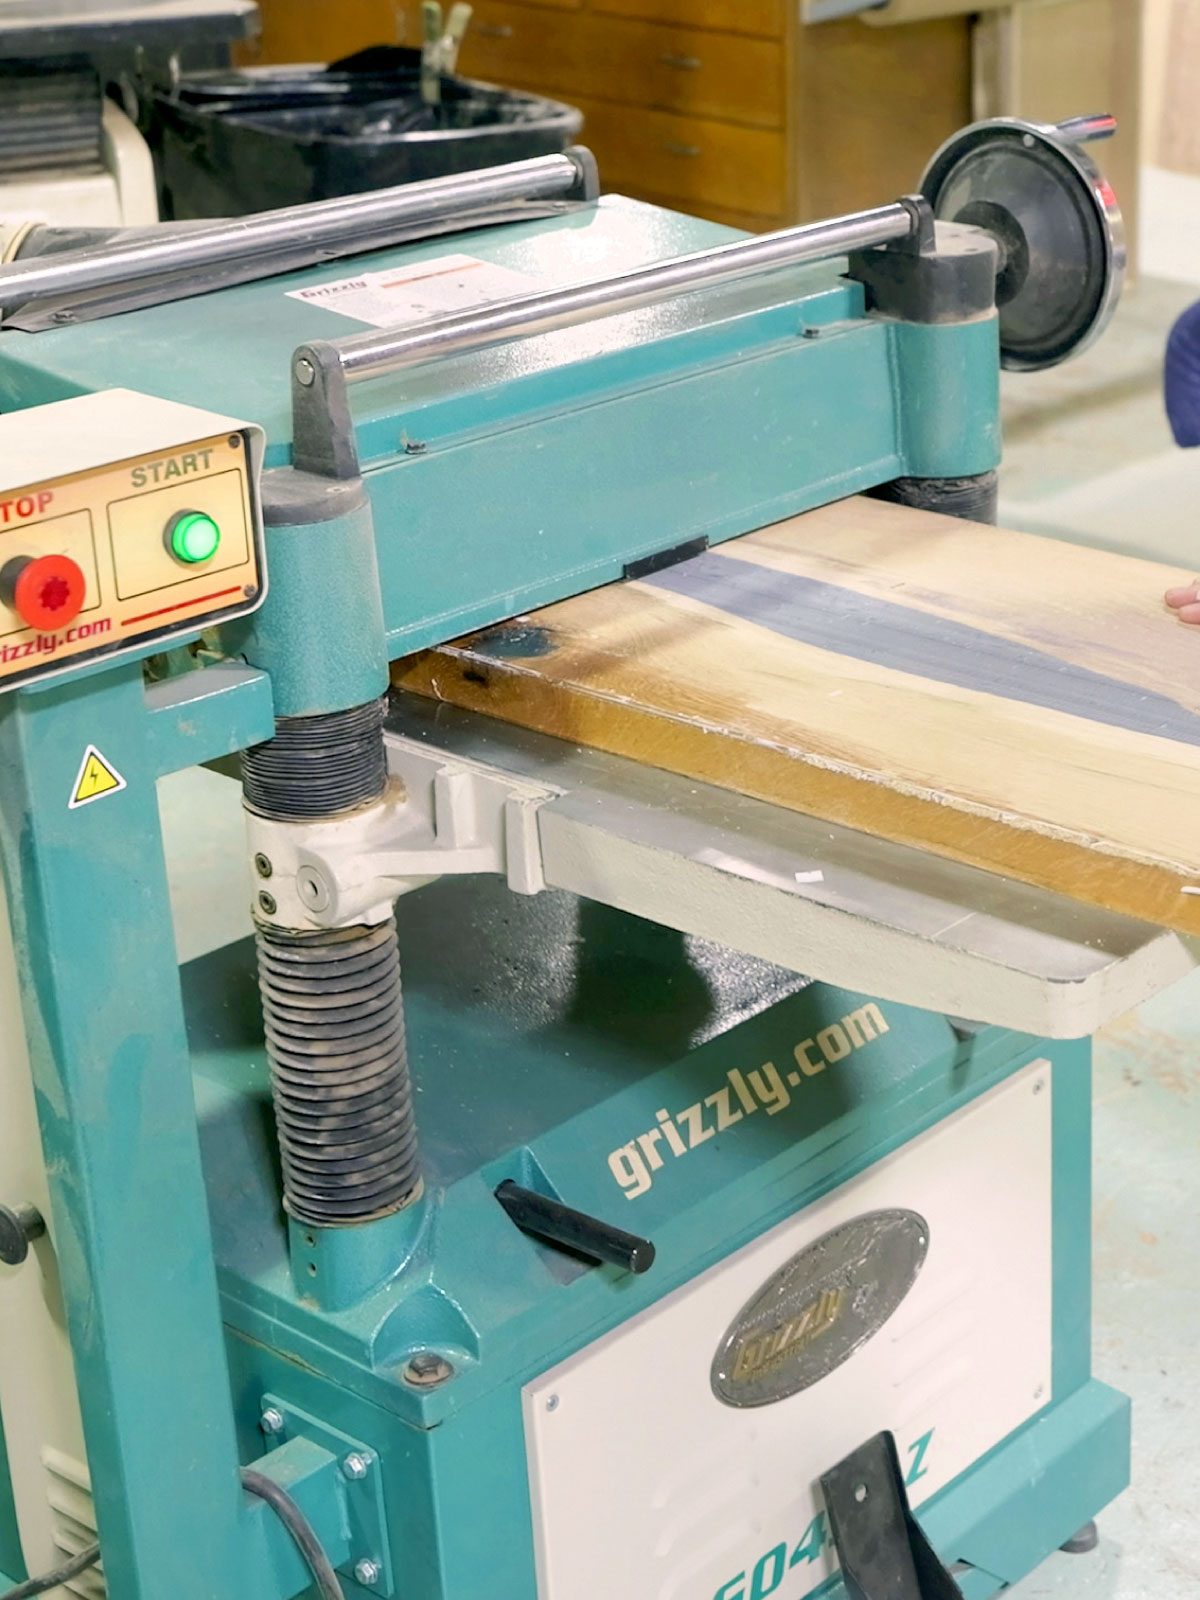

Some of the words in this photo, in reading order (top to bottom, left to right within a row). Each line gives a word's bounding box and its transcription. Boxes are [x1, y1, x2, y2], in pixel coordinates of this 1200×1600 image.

[131, 449, 213, 488] START
[0, 618, 111, 663] izzly.com
[607, 1003, 890, 1200] grizzly.com
[713, 1427, 935, 1600] G04Z
